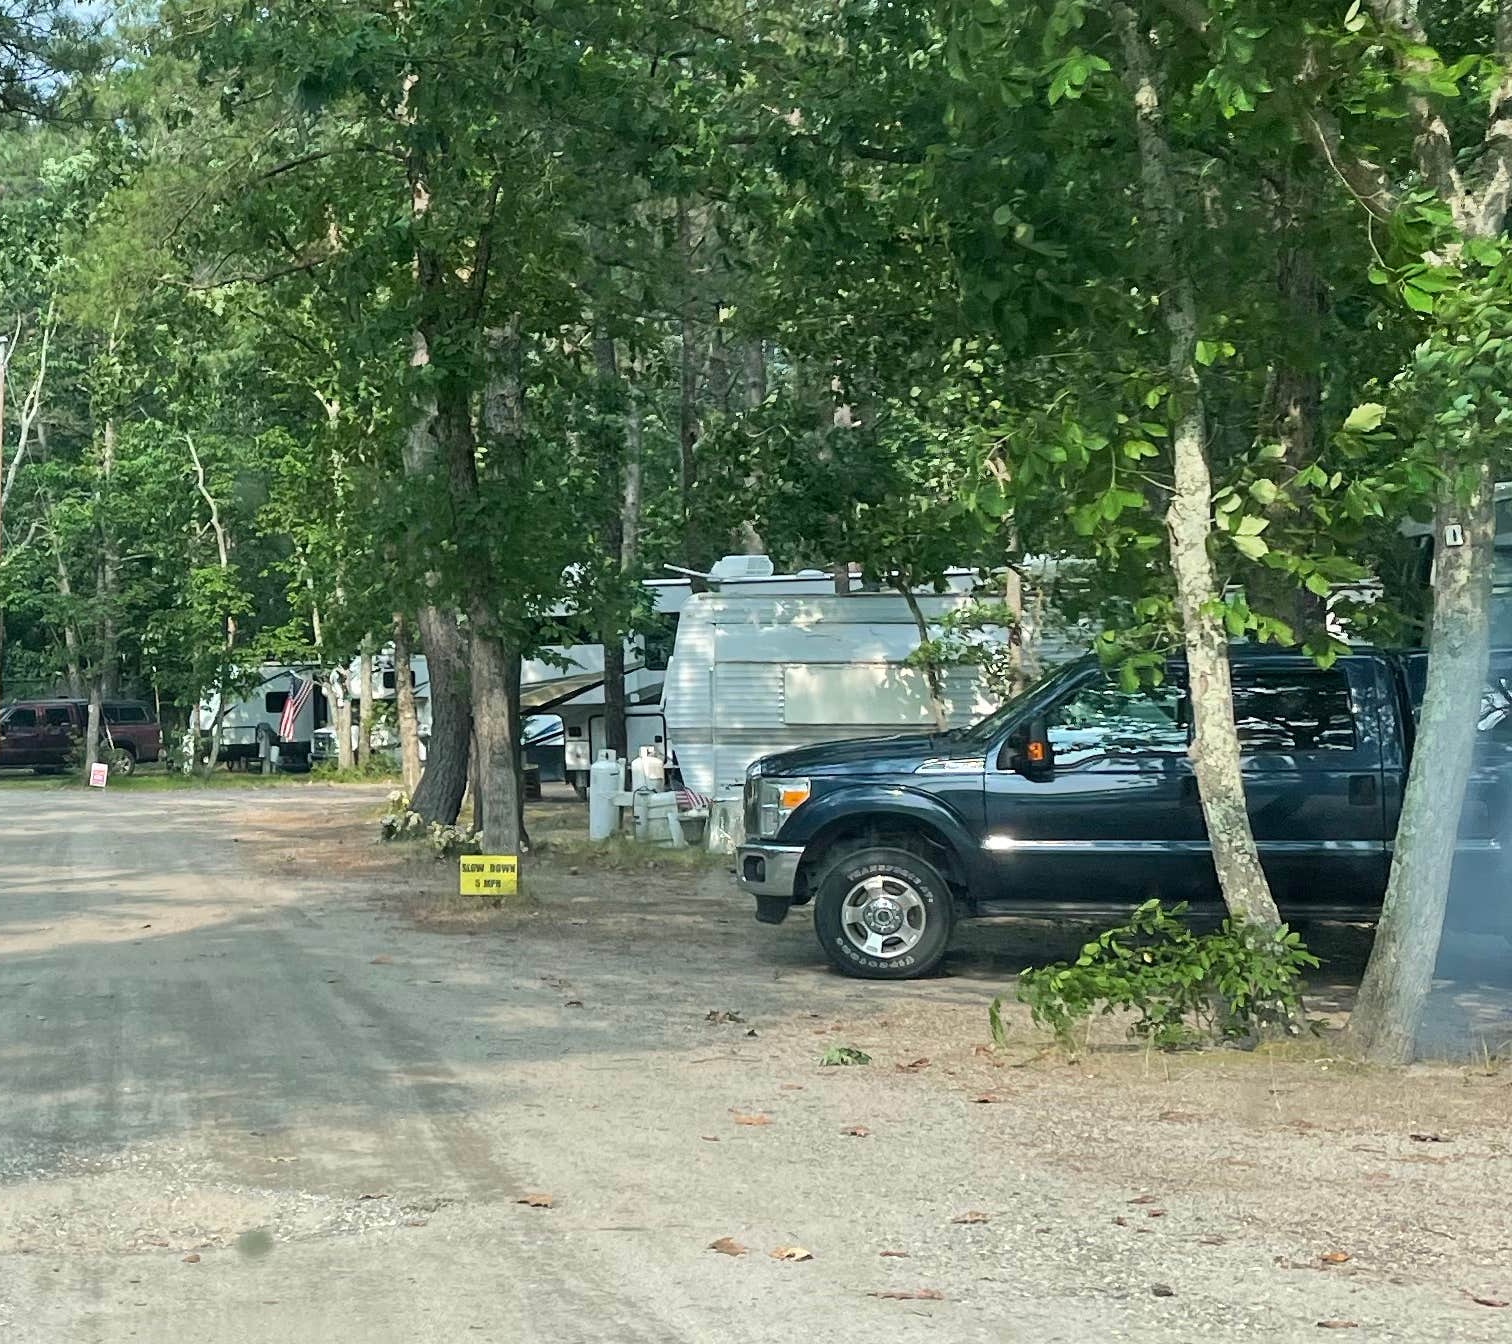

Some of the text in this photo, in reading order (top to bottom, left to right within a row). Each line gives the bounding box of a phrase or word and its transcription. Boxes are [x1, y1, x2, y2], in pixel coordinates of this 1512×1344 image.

[462, 863, 516, 873] SLOW DOWN
[474, 879, 502, 888] 5 MPH
